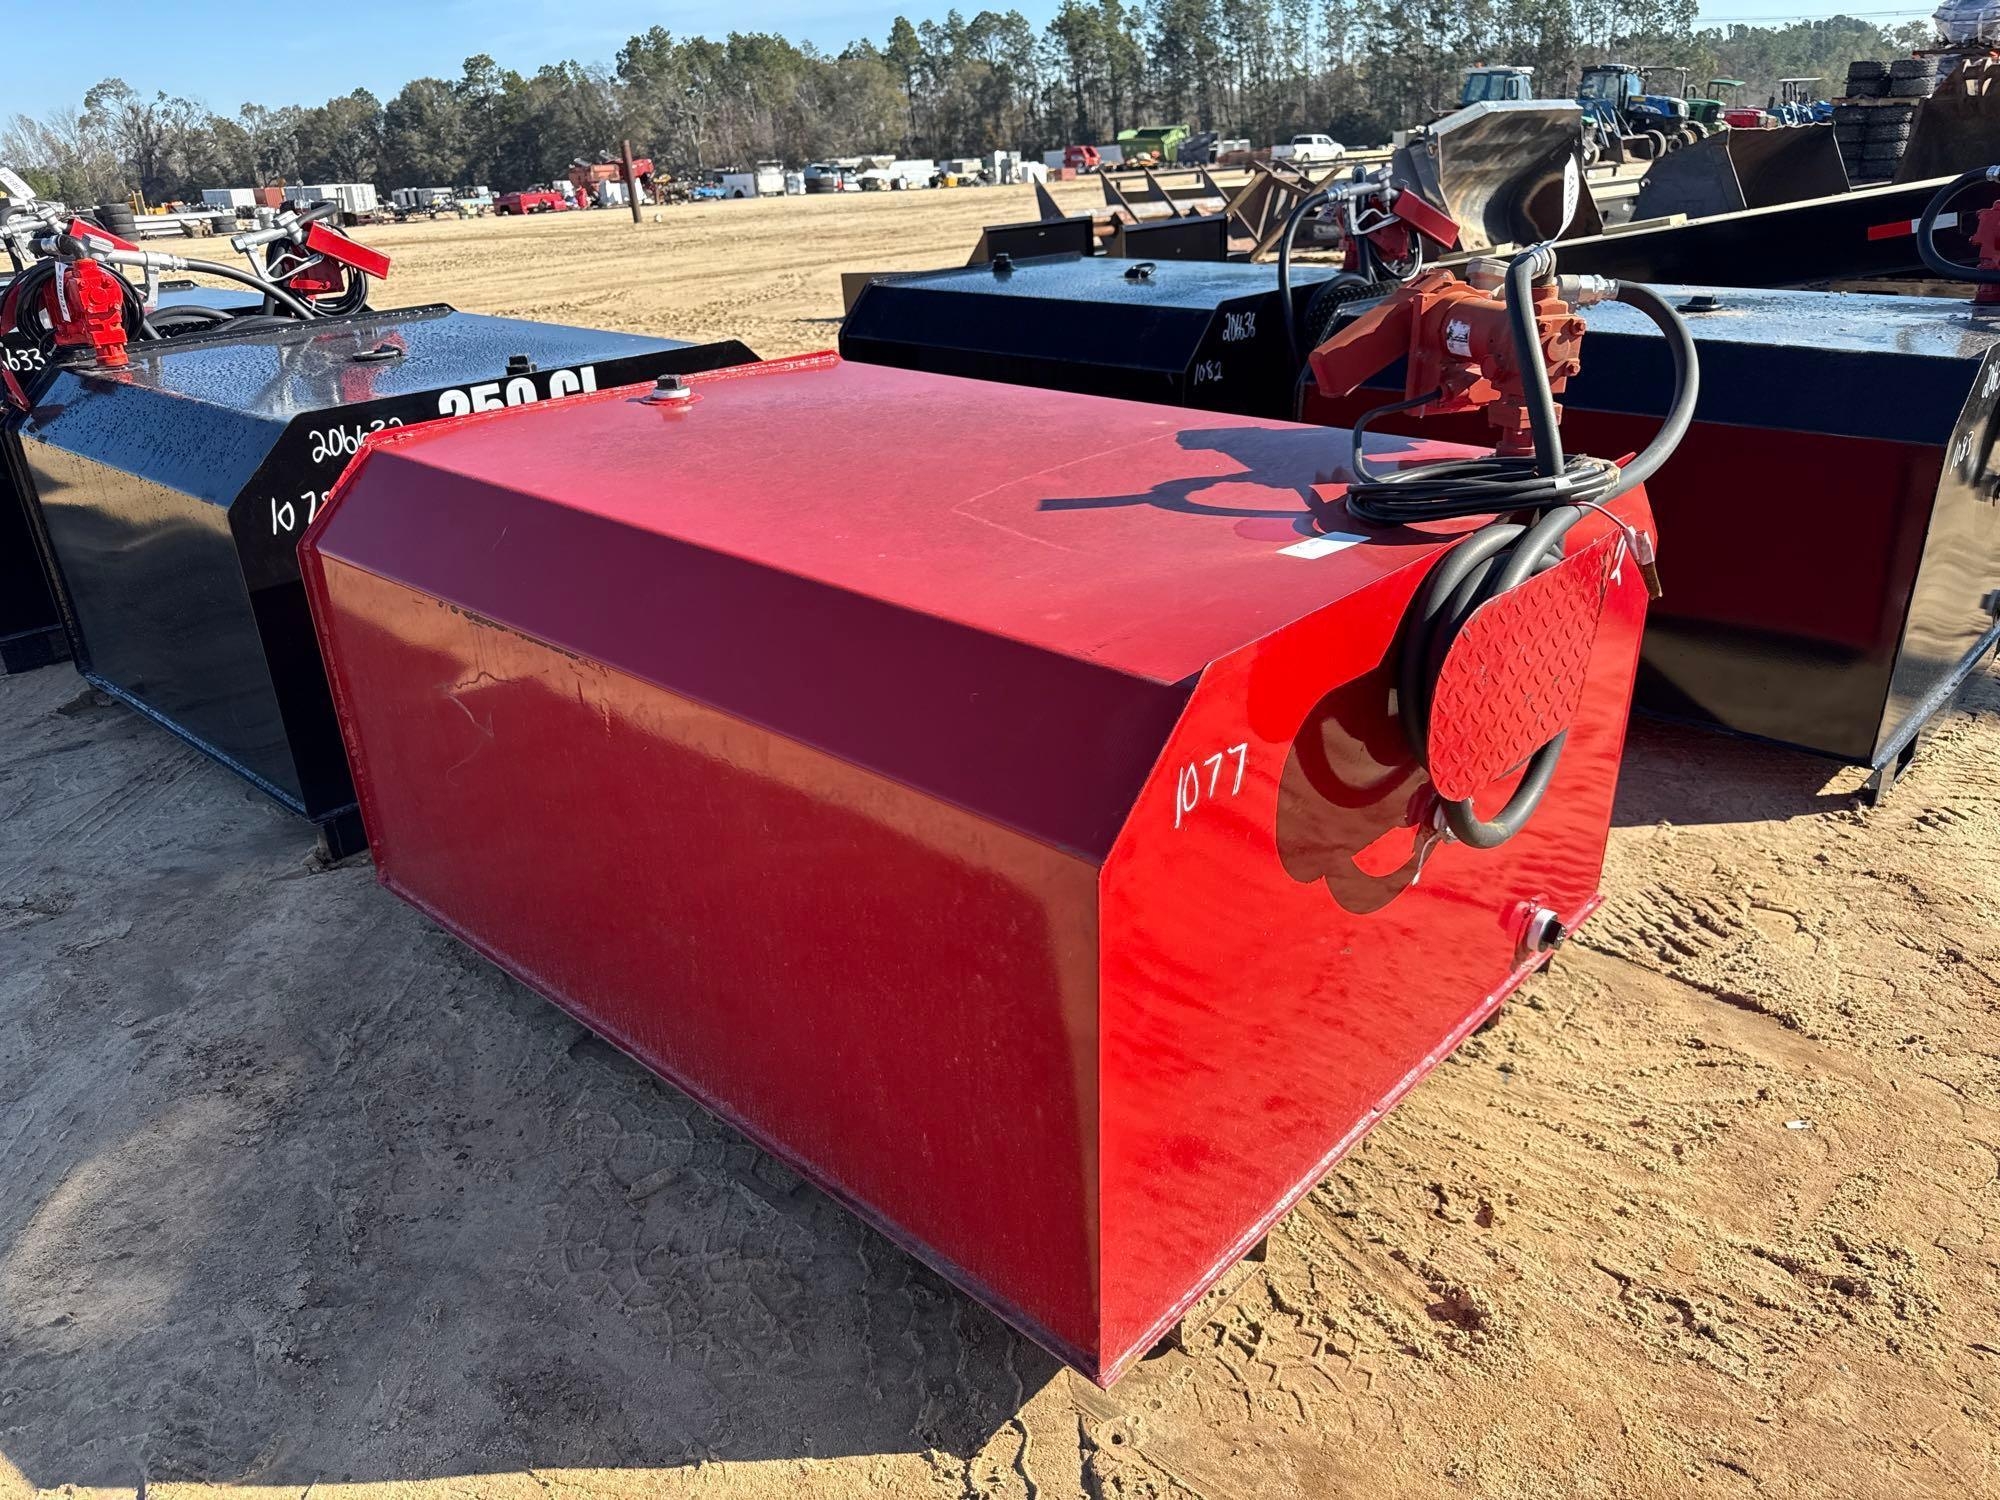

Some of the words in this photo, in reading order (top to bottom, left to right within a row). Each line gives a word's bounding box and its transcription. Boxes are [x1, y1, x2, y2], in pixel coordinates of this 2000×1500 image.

[1193, 359, 1224, 386] 1082
[1948, 430, 1976, 476] 1083
[1174, 742, 1249, 829] 1077
